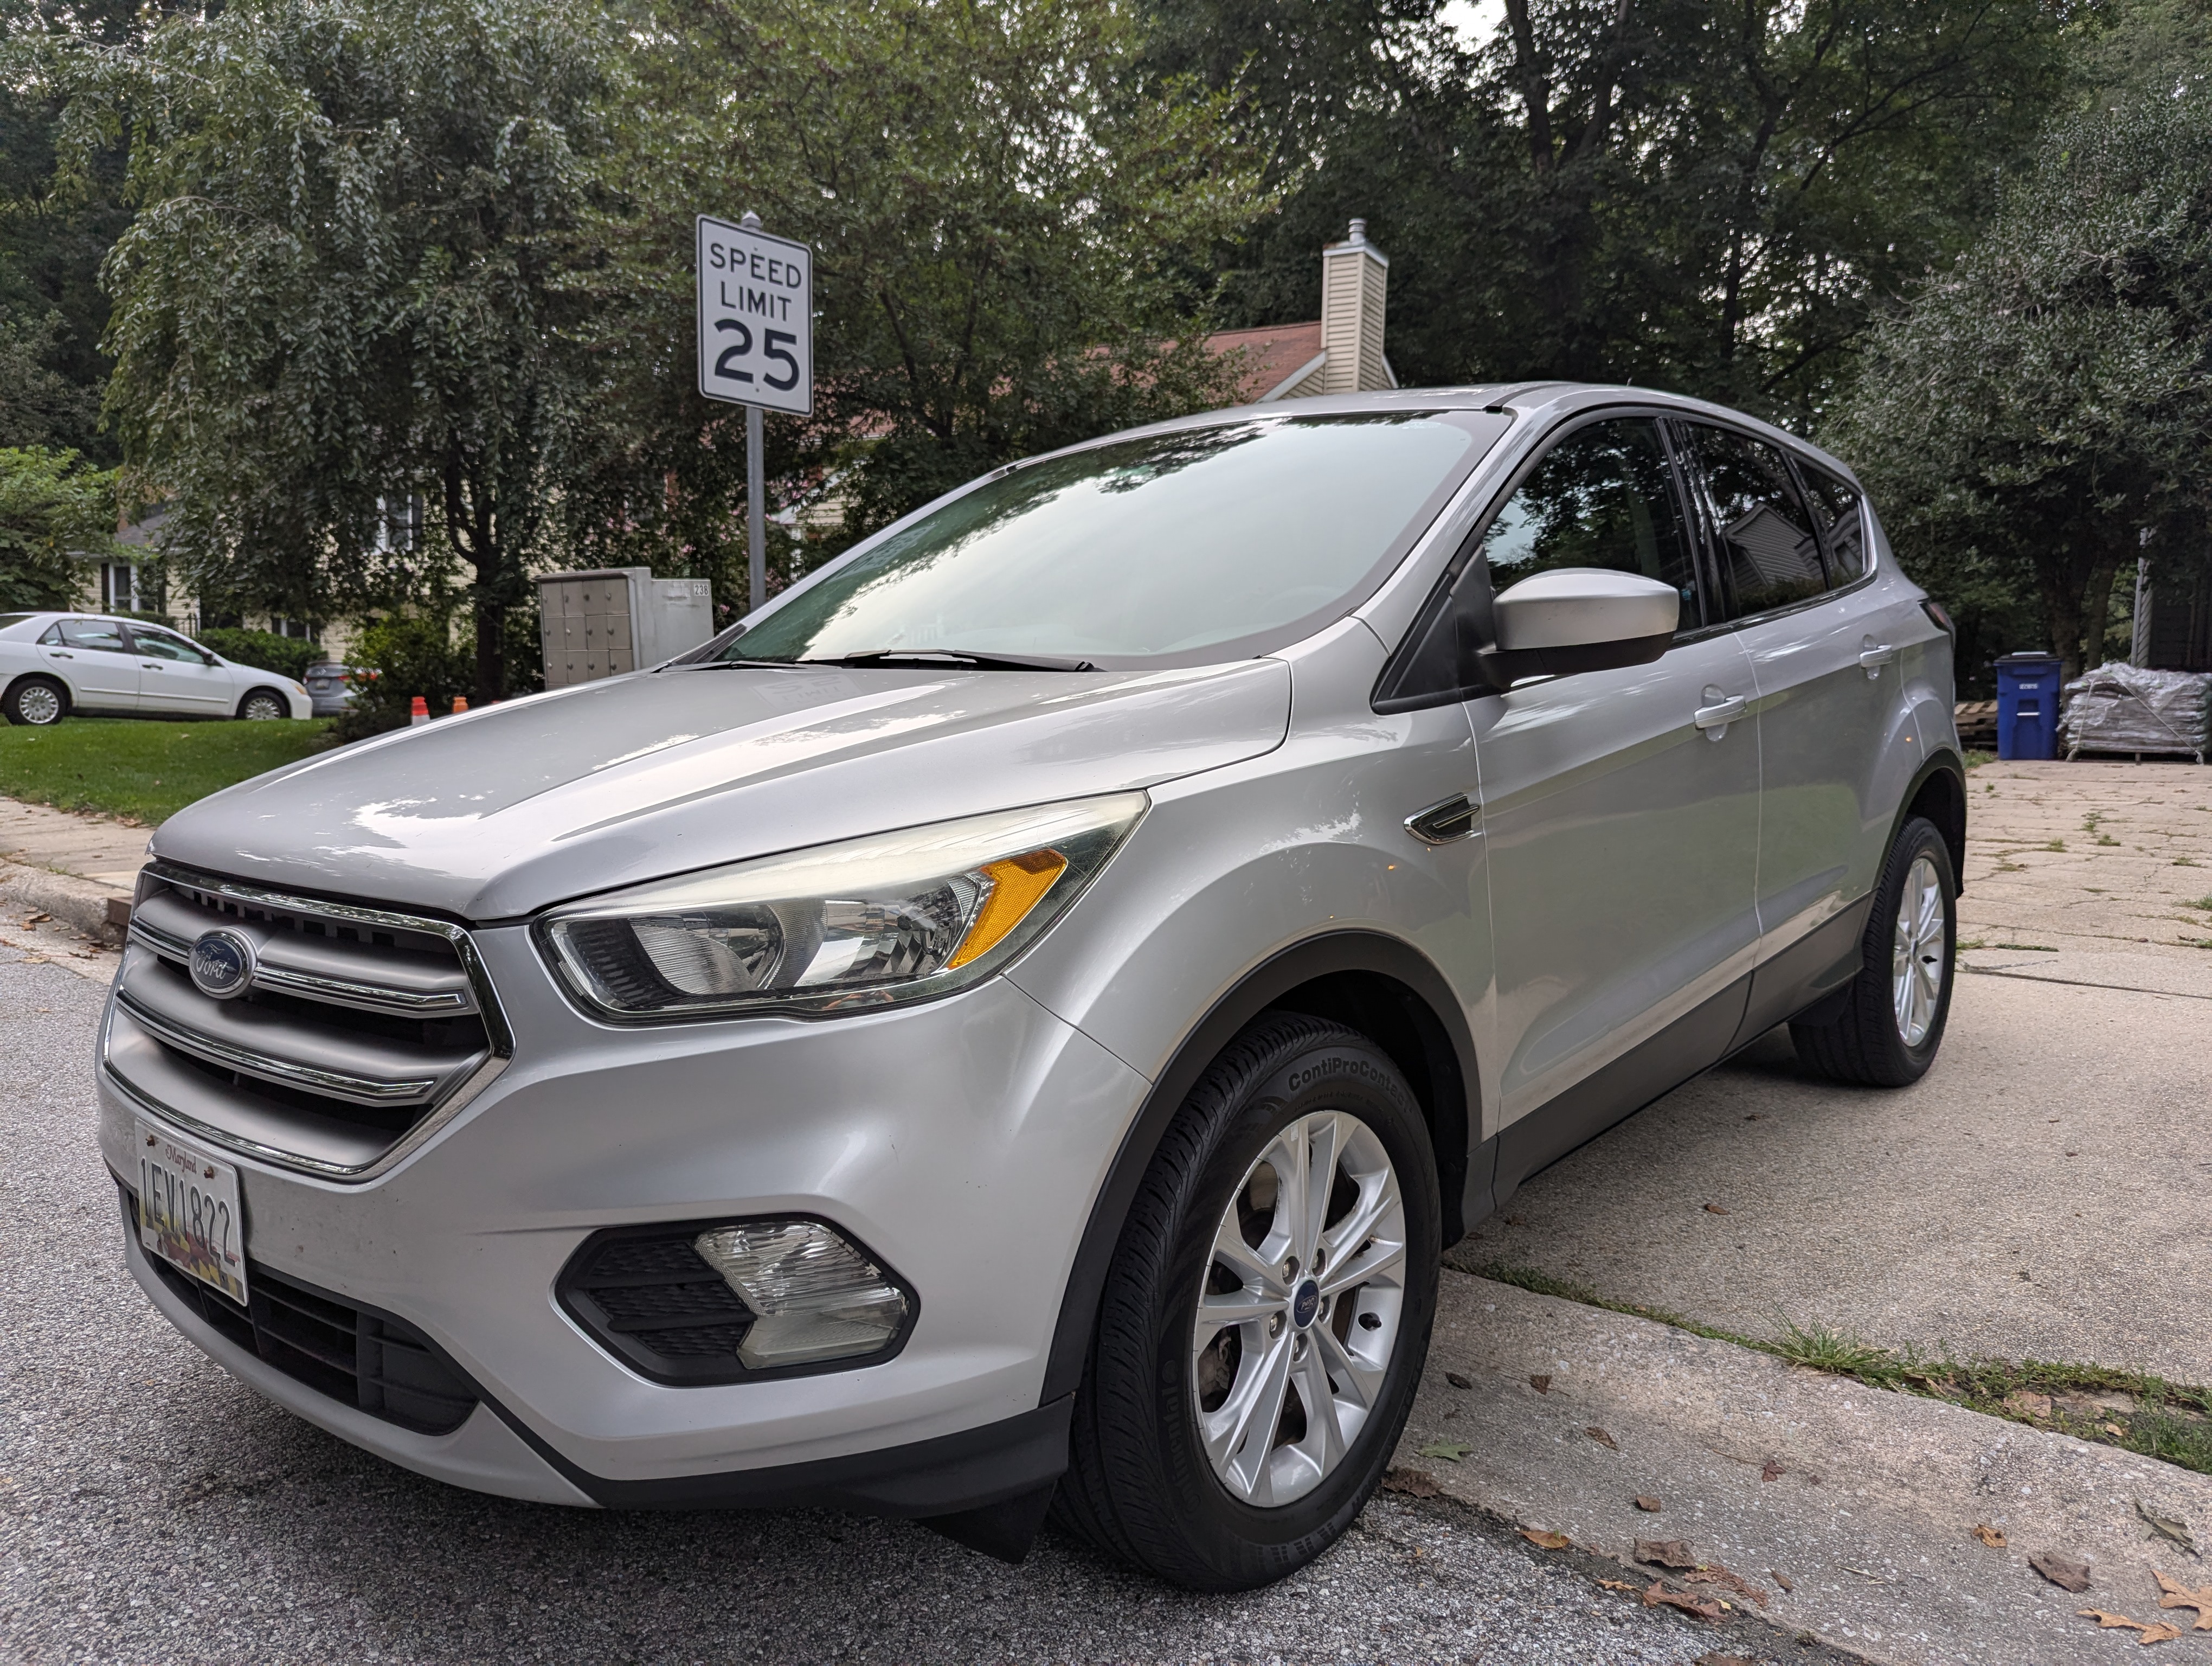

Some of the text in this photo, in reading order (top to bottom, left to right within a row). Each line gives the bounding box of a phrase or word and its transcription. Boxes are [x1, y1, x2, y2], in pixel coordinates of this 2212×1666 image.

[710, 242, 802, 289] SPEED
[721, 281, 792, 322] LIMIT
[714, 318, 800, 392] 25
[695, 585, 709, 595] 238
[165, 1144, 197, 1175] Maryland
[141, 1158, 236, 1267] 1EV1822
